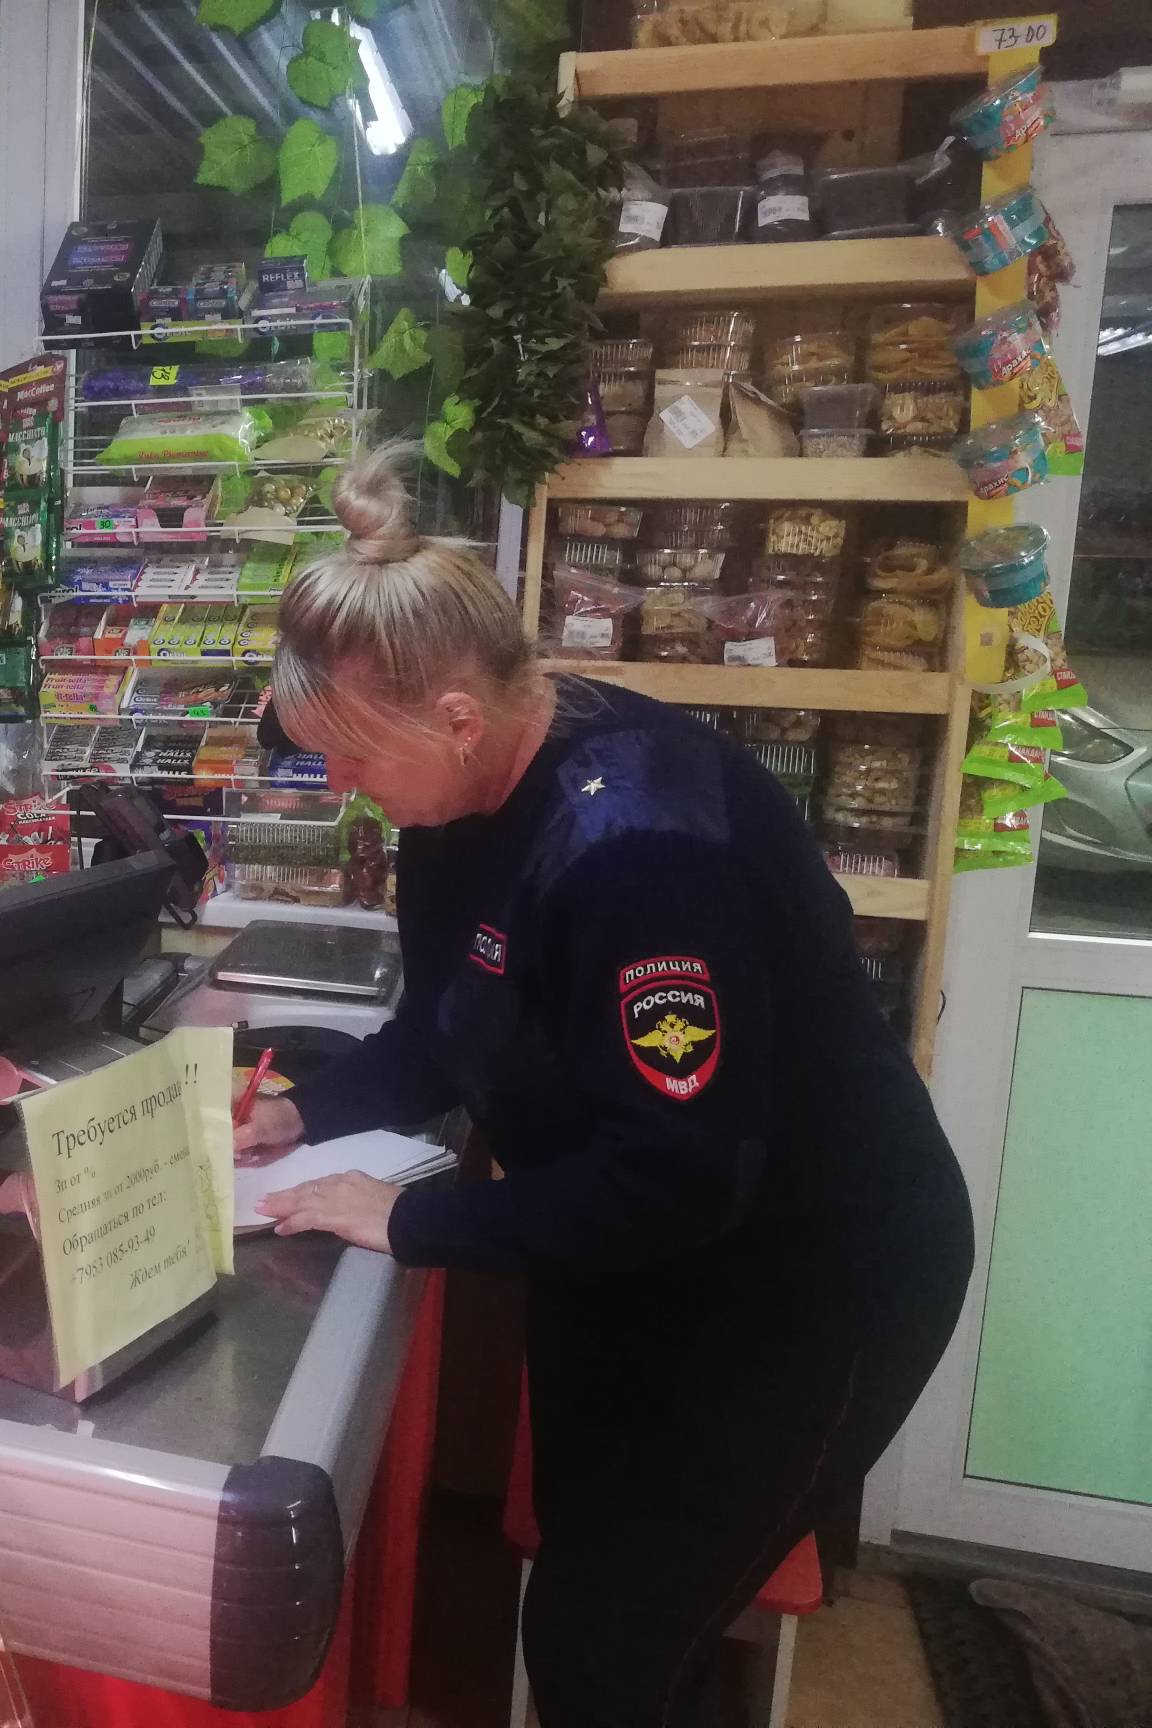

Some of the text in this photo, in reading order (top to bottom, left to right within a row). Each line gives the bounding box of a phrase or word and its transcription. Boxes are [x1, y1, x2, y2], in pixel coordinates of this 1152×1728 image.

[297, 752, 326, 760] HALL
[624, 960, 703, 984] ПОЛИЦИЯ
[633, 990, 706, 1018] РОССИЯ
[666, 1075, 699, 1094] МВД
[51, 1104, 138, 1159] Требуется
[70, 1174, 81, 1187] от
[62, 1210, 130, 1256] Обращаться
[132, 1203, 144, 1218] по
